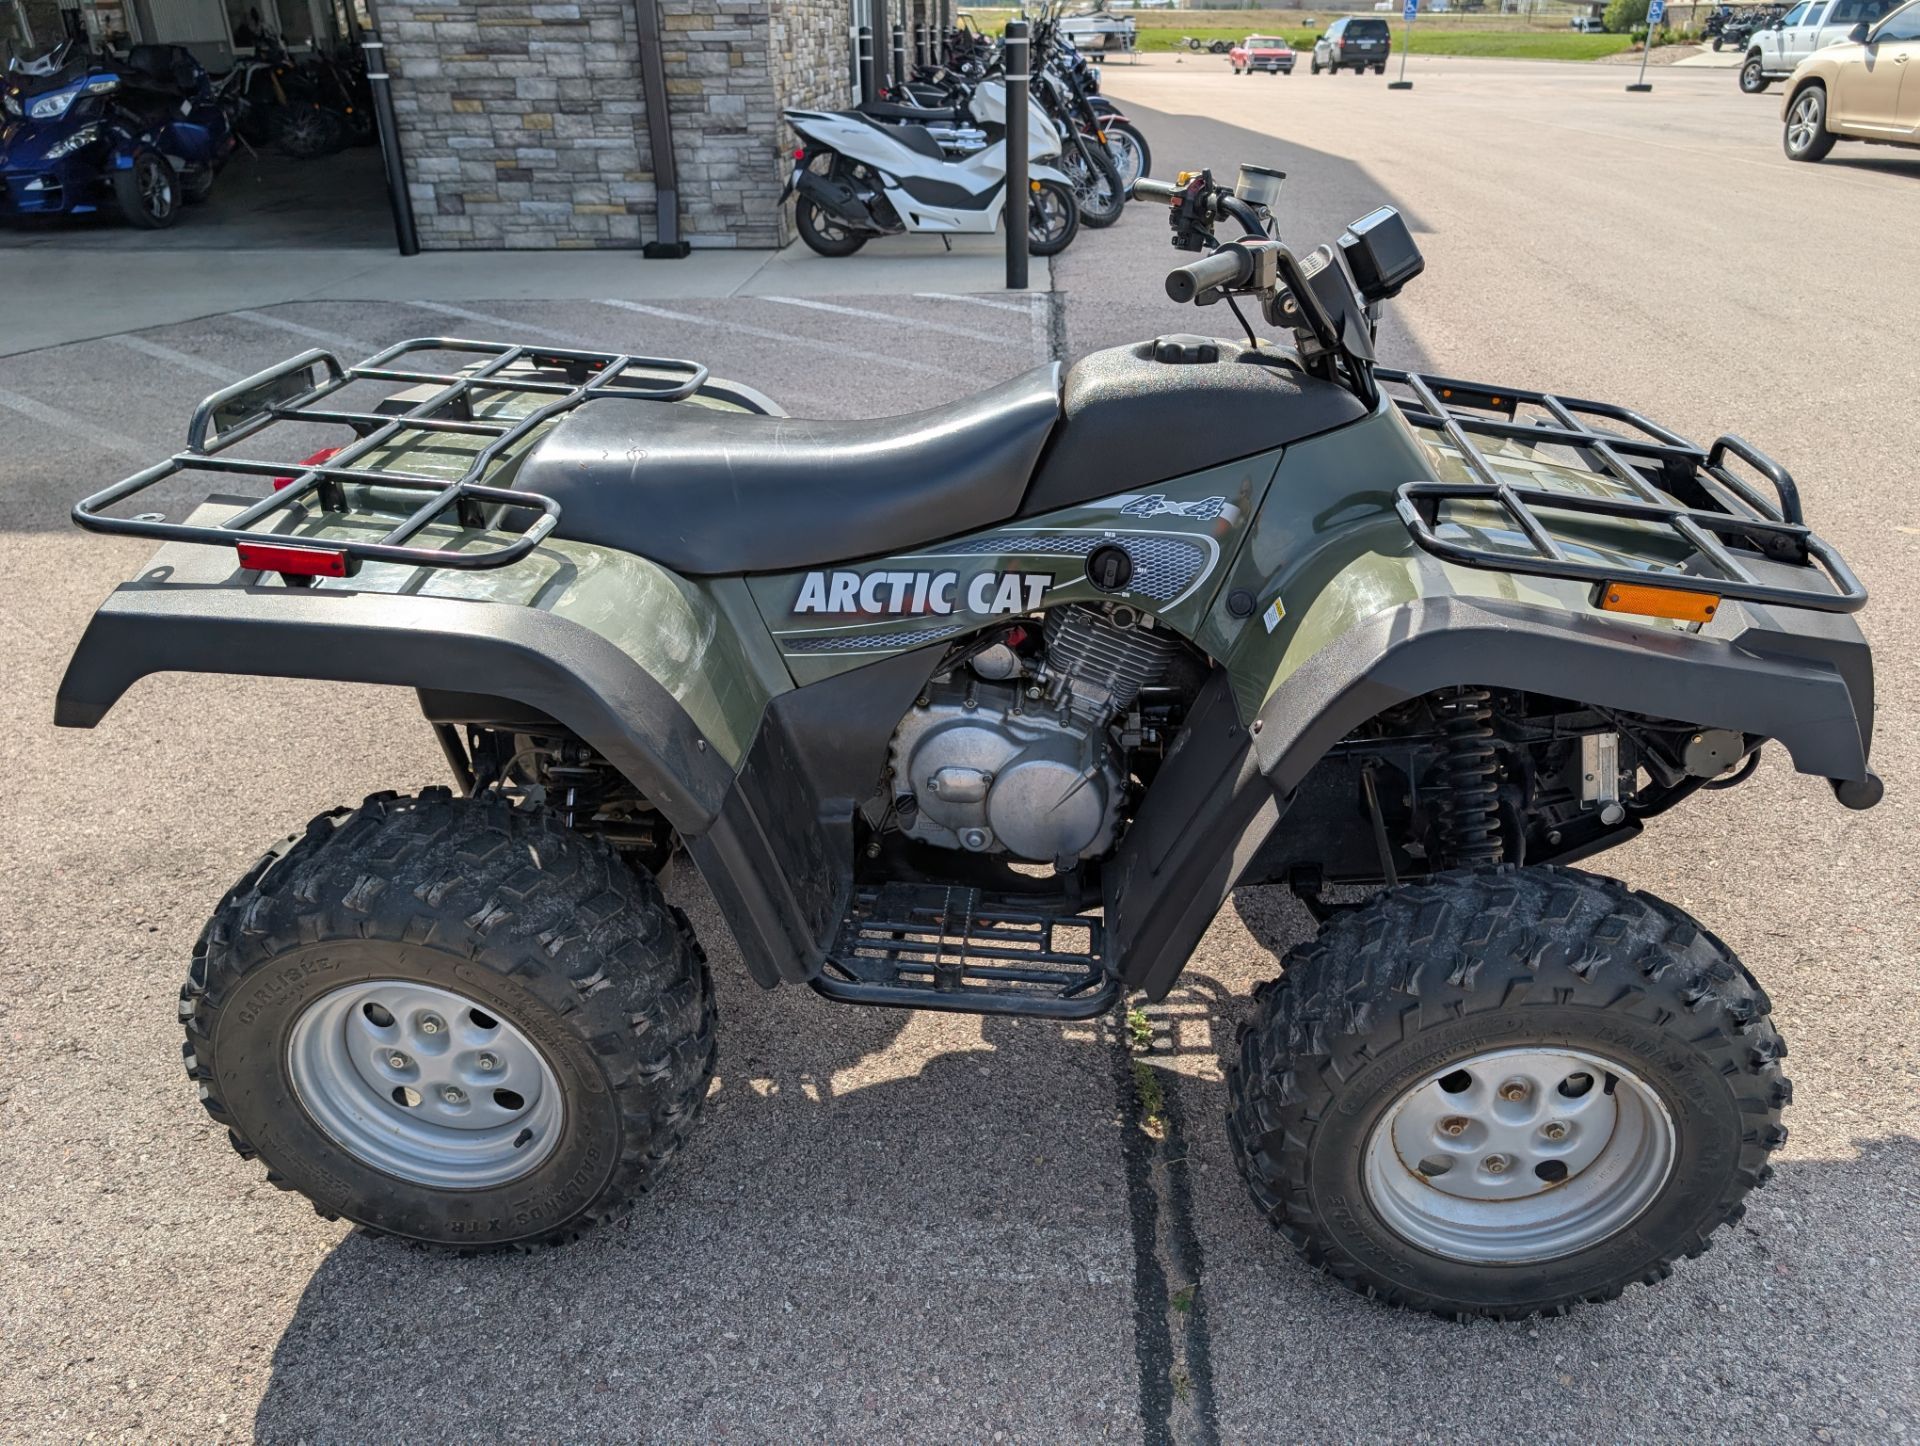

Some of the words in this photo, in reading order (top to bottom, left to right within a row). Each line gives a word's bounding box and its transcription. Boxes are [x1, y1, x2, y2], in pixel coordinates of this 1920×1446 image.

[793, 571, 958, 615] ARCTIC
[966, 572, 1053, 614] CAT
[237, 956, 334, 1026] CARLISLE
[515, 1147, 600, 1226] BADLANDS
